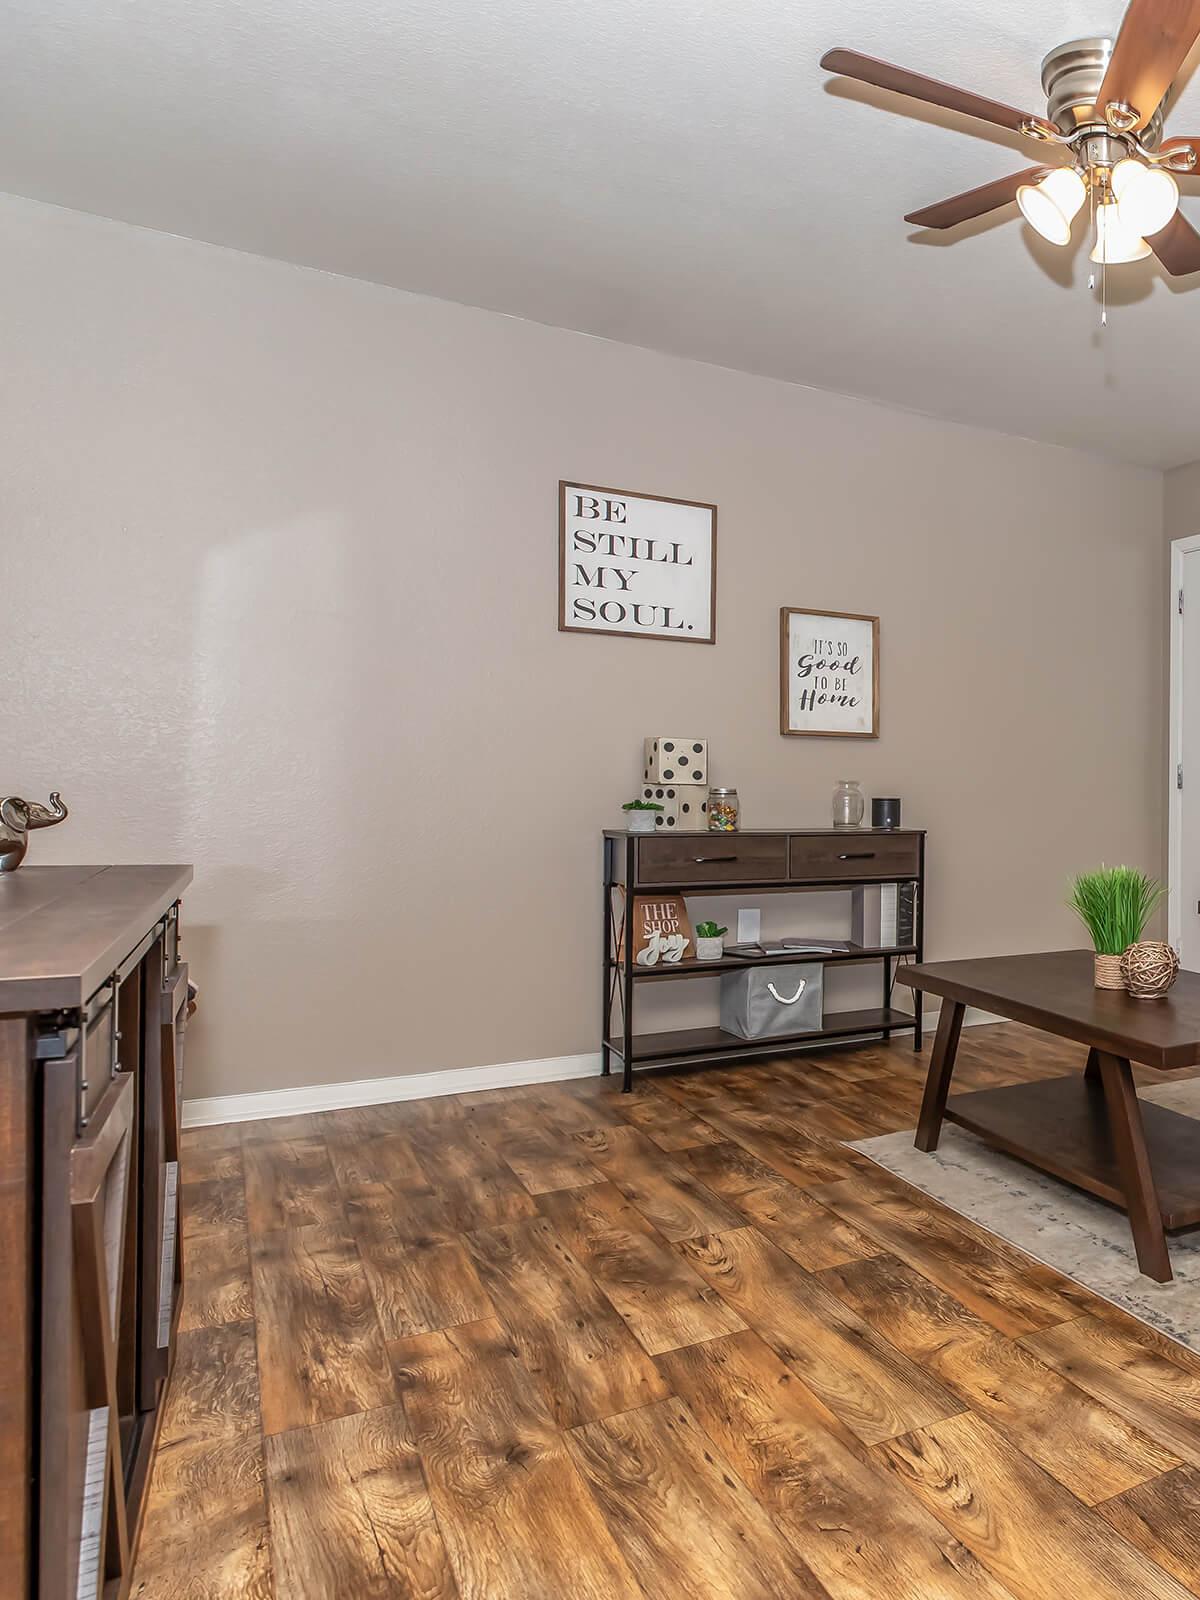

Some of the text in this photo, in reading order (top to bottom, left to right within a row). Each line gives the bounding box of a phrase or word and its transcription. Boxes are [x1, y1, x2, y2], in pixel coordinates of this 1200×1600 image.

[573, 494, 627, 524] BE
[573, 529, 693, 566] STILL
[572, 563, 639, 591] MY
[573, 597, 694, 631] SOUL.
[814, 639, 848, 657] IT'S SO
[797, 654, 863, 678] Good
[813, 676, 847, 691] TO BE
[799, 689, 862, 711] Home
[640, 903, 678, 921] THE
[643, 919, 679, 935] SHOP
